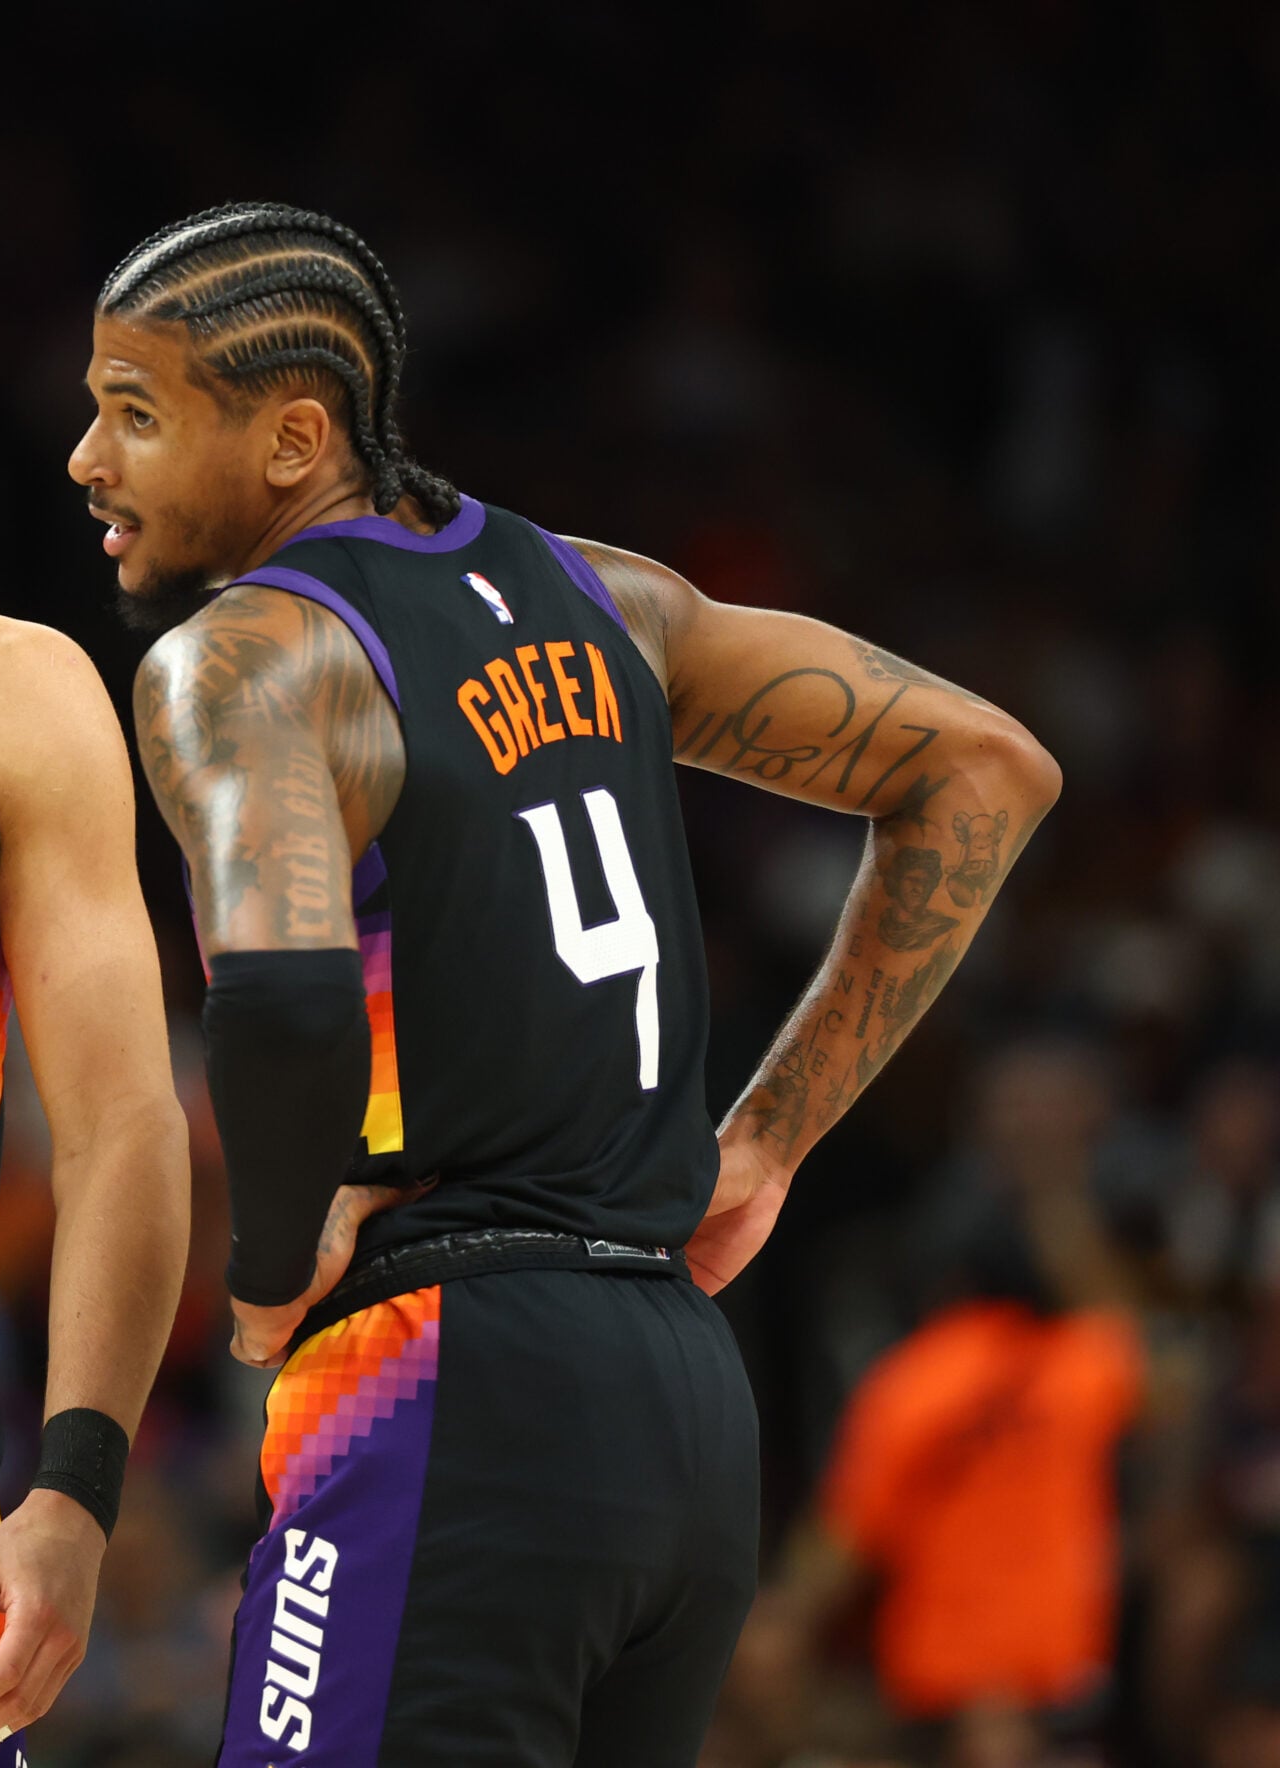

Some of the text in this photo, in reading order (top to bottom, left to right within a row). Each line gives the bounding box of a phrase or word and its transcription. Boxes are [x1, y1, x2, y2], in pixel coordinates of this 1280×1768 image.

[457, 640, 622, 775] GREEN
[513, 785, 660, 1092] 4
[259, 1528, 339, 1753] SUNS
